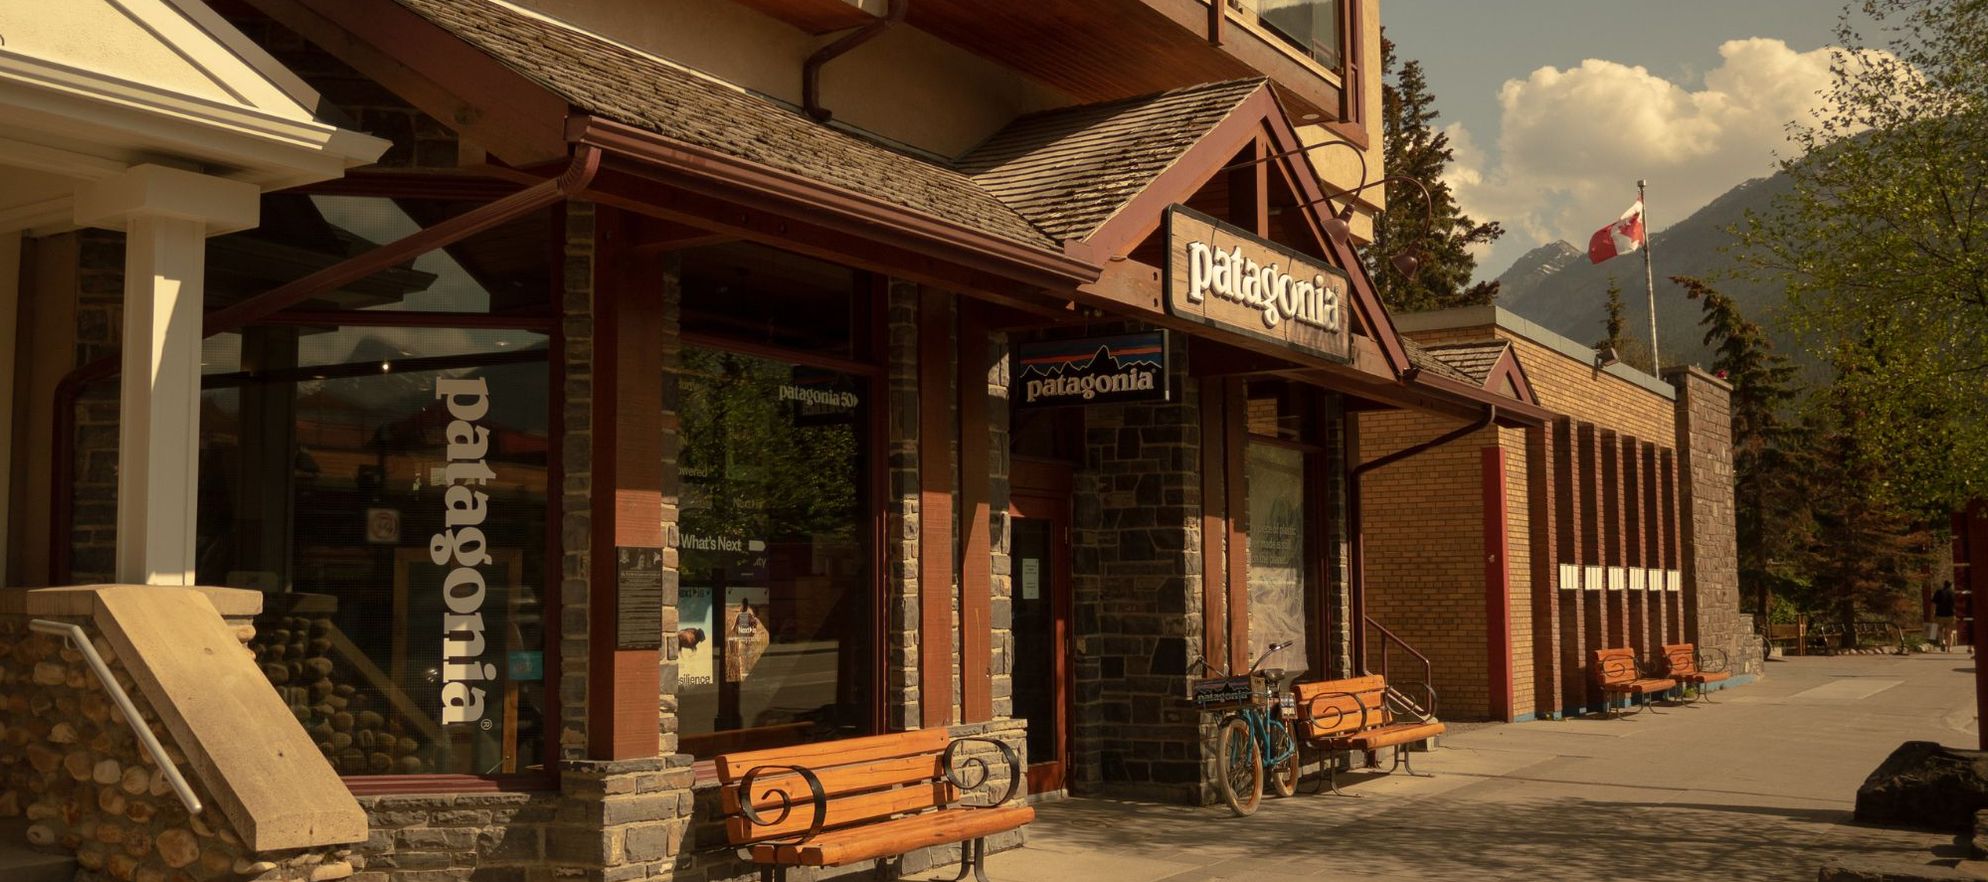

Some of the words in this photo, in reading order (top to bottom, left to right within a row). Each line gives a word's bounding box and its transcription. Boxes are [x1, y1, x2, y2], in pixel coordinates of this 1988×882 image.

[778, 384, 840, 407] patagonia
[681, 534, 716, 551] What's
[718, 536, 742, 551] Next
[678, 673, 711, 685] silience
